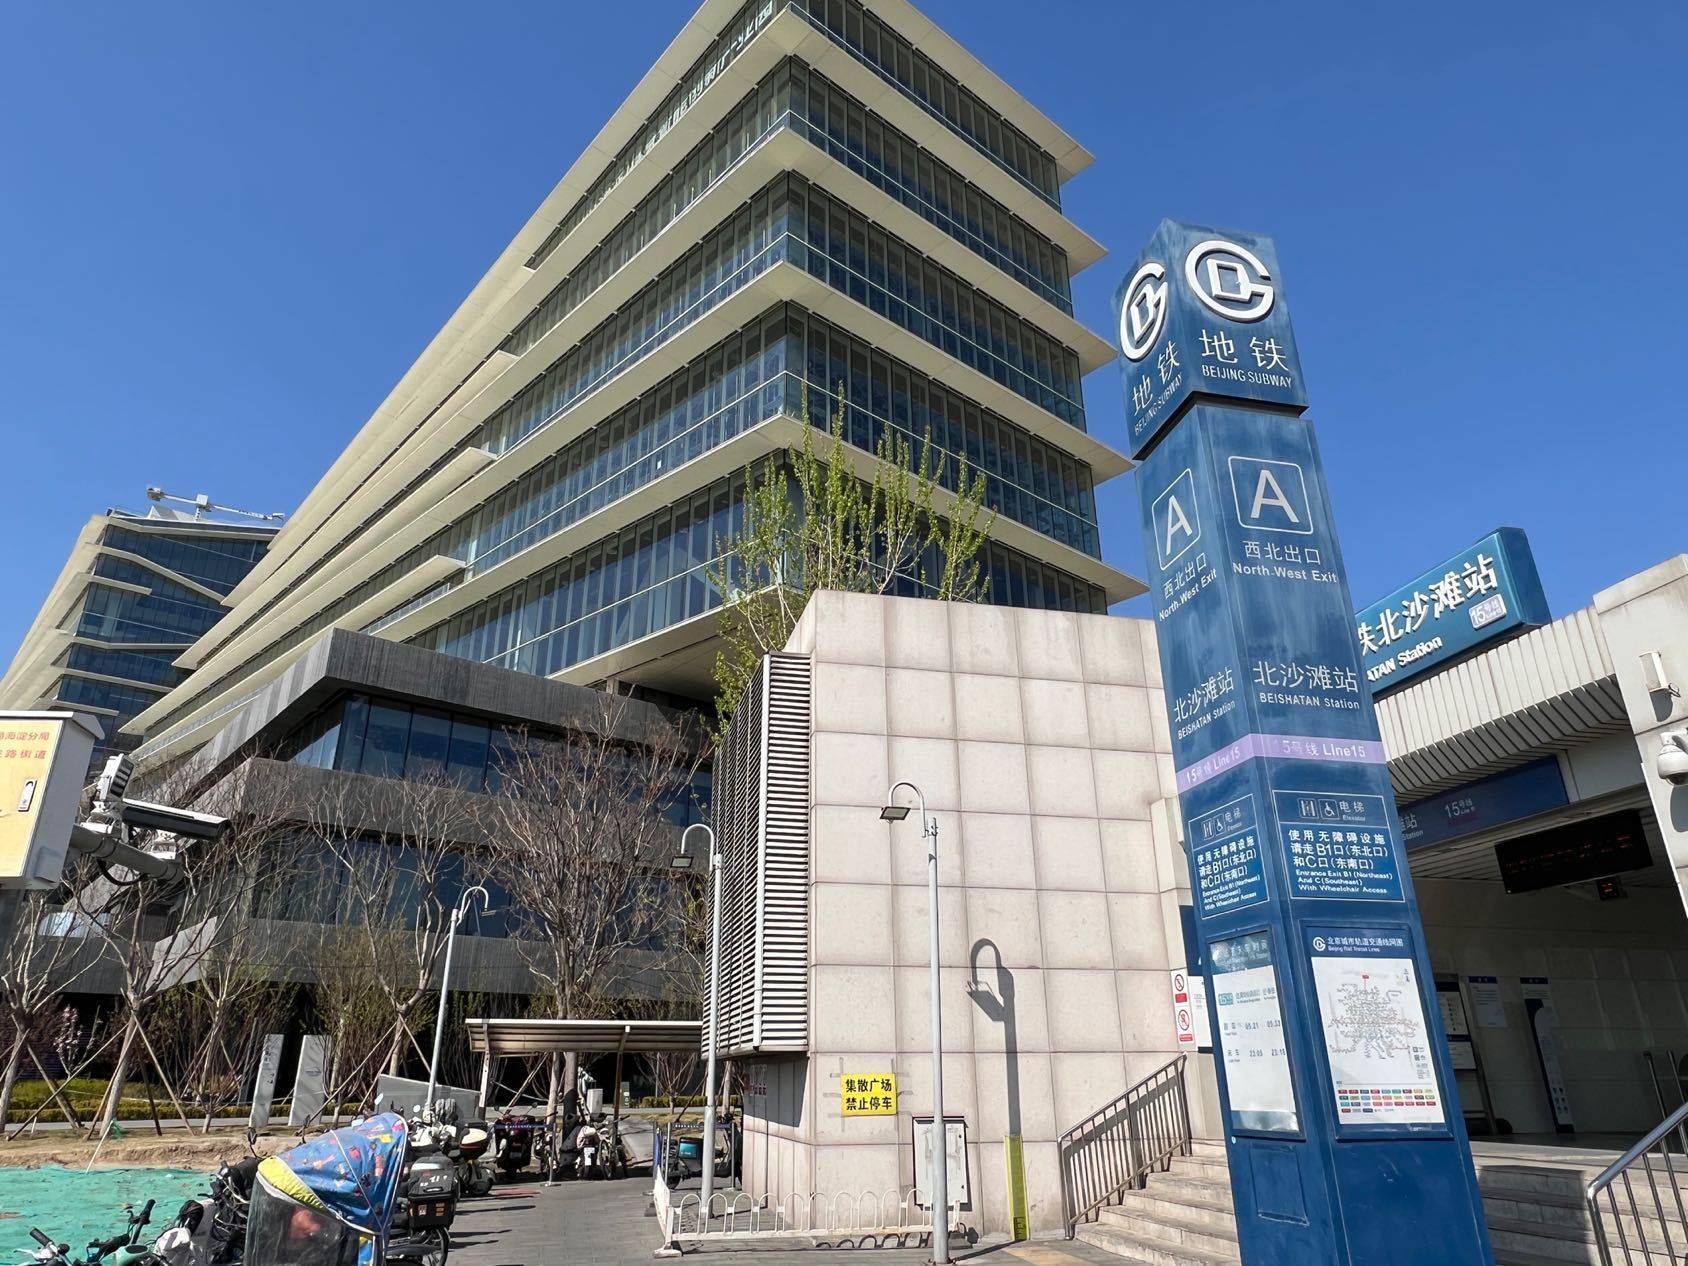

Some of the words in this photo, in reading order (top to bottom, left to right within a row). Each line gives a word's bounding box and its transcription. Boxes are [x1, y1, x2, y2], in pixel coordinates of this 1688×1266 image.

[1198, 329, 1290, 372] 地铁
[1132, 340, 1180, 416] 地铁
[1202, 364, 1246, 382] BEIJING
[1248, 371, 1292, 389] SUBWAY
[1135, 403, 1158, 436] BEIJING
[1158, 372, 1183, 408] SUBWAY
[1250, 469, 1300, 523] A
[1165, 495, 1193, 556] A
[1243, 540, 1321, 565] 西北出口
[1163, 552, 1207, 599] 西北出口
[1200, 568, 1217, 588] Exit
[1311, 570, 1337, 583] Exit
[1398, 635, 1443, 666] Station
[1253, 661, 1360, 693] 北沙滩站
[1174, 666, 1234, 722] 北沙滩站
[1260, 692, 1320, 706] BEISHATAN
[1324, 697, 1360, 710] Station
[1178, 713, 1212, 739] BEISHATAN
[1213, 700, 1236, 719] Station
[1339, 800, 1365, 813] 电梯
[845, 1078, 893, 1093] 集散广场
[845, 1097, 893, 1111] 禁止停车
